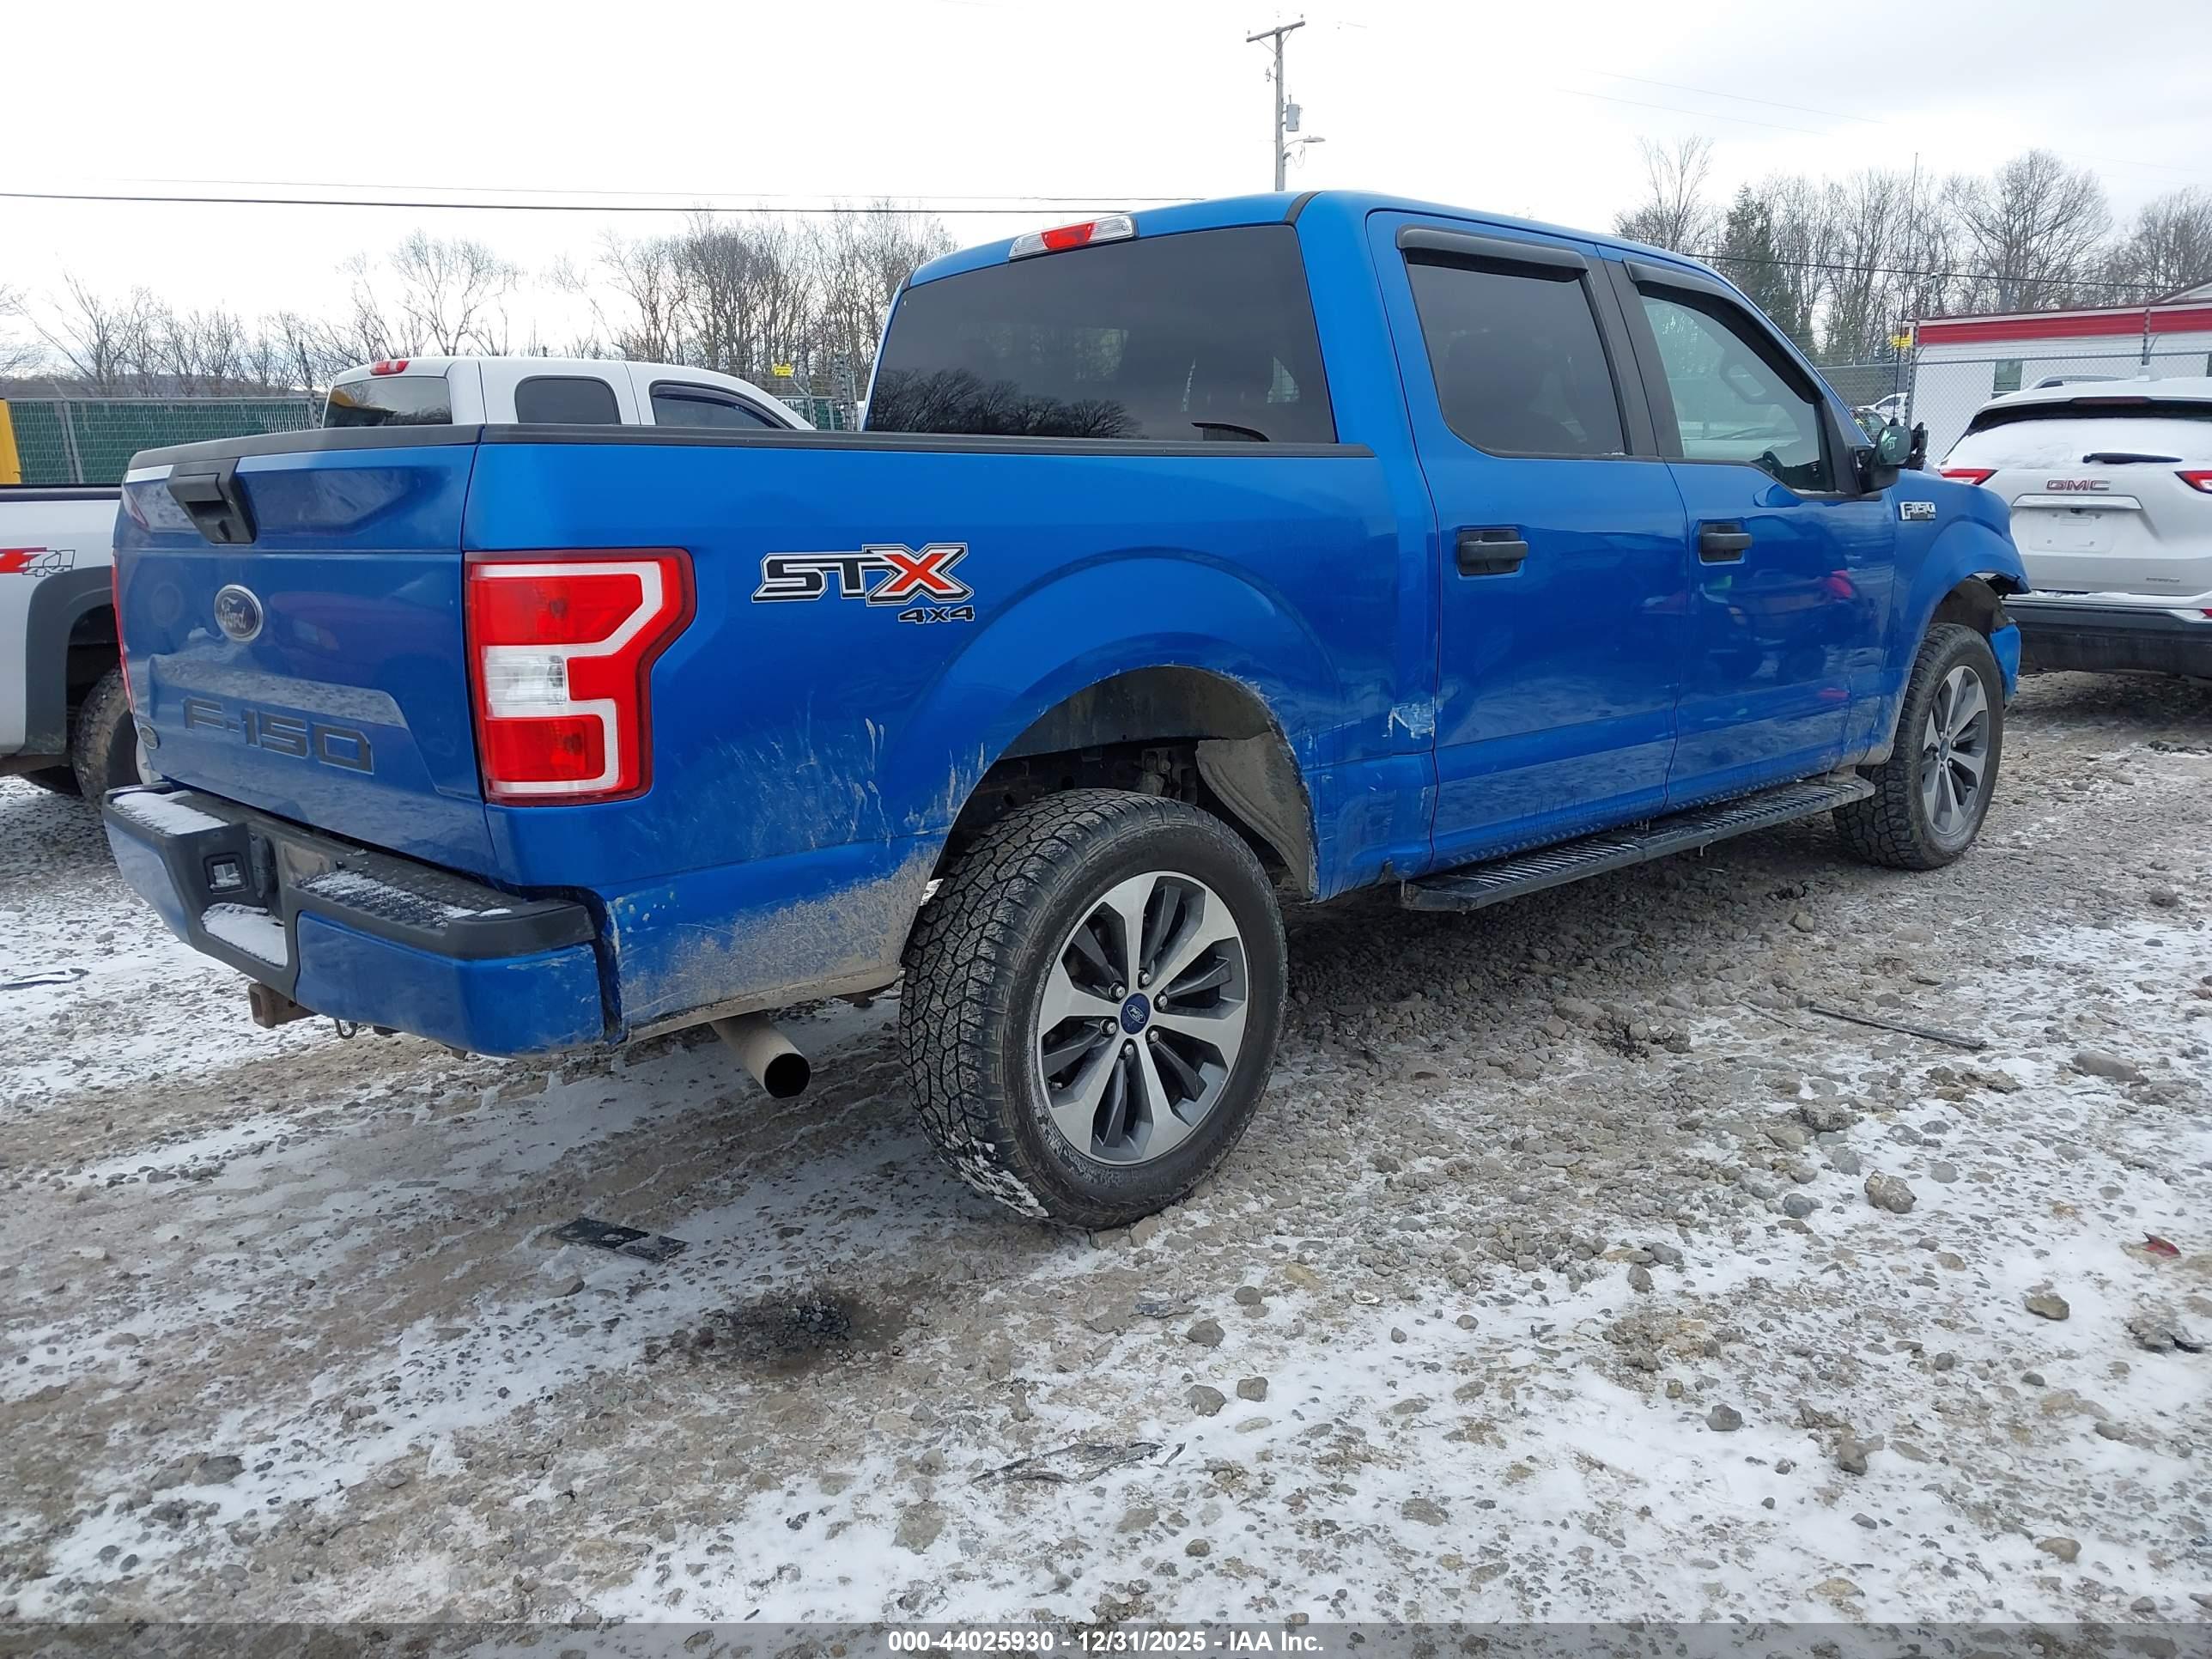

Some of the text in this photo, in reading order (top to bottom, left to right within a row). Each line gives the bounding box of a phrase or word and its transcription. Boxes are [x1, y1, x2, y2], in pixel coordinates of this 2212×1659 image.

[2047, 479, 2110, 491] GMC
[751, 542, 975, 607] STX
[221, 596, 247, 629] Ford
[182, 696, 374, 775] F-150
